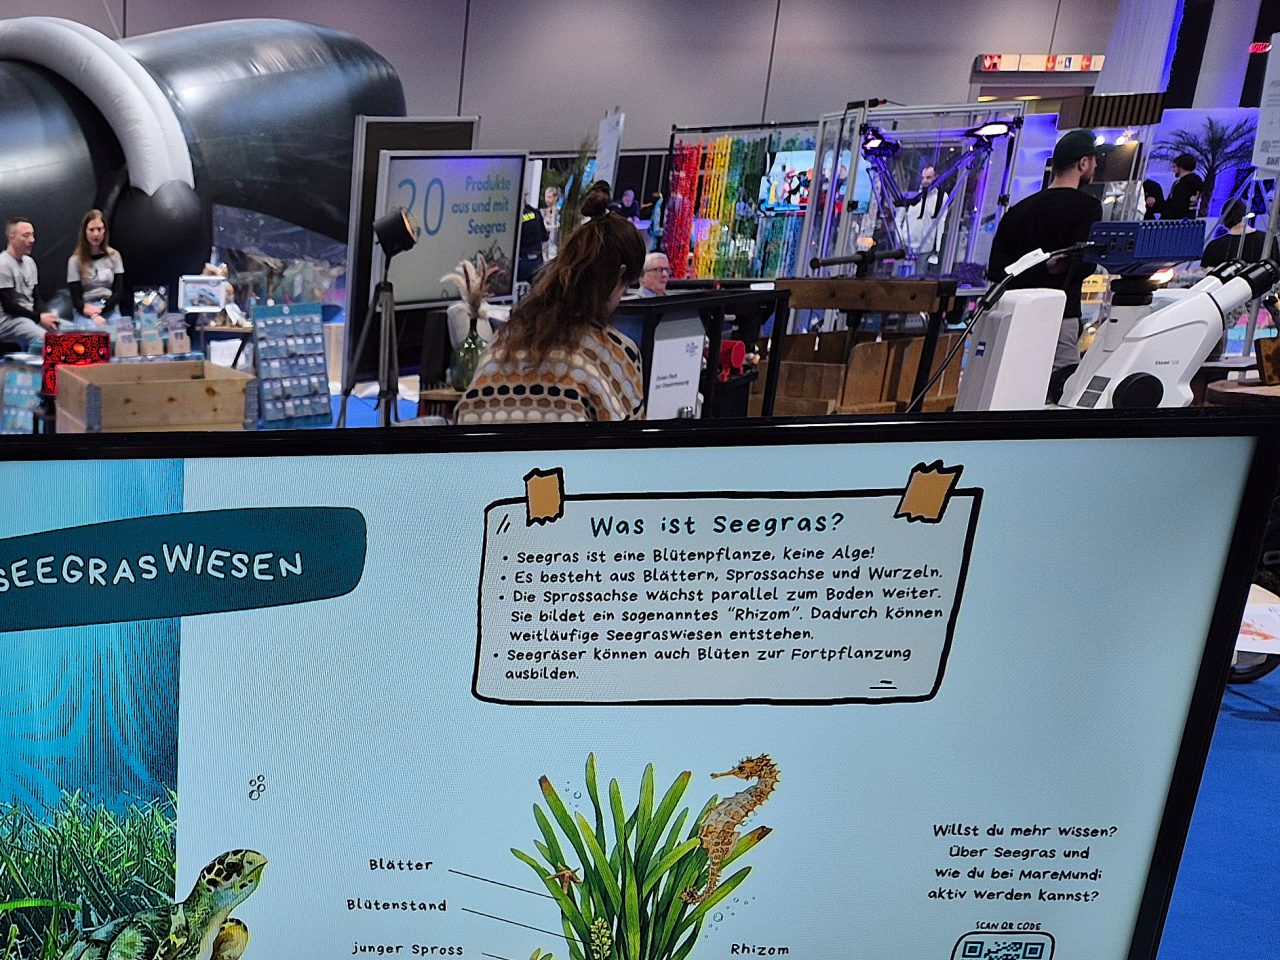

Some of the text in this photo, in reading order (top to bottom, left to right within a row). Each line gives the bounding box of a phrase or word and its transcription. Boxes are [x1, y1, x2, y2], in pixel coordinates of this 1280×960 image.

[466, 175, 512, 191] Produkte
[451, 197, 509, 213] aus und mit
[467, 218, 507, 238] Seegras
[590, 512, 844, 538] Was ist Seegras?
[516, 544, 875, 566] Seegras ist eine Blütenpflanze, keine Alge!
[515, 564, 942, 584] Es besteht aus Blättern, Sprossachse und Wurzeln.
[513, 590, 536, 603] Die
[543, 588, 638, 606] Sprossachse
[711, 586, 778, 604] parallel
[786, 590, 818, 602] zum
[826, 585, 873, 601] Boden
[511, 611, 532, 623] Sie
[539, 608, 586, 625] bildet
[593, 610, 615, 622] ein
[621, 609, 718, 625] sogenanntes
[811, 605, 878, 620] Dadurch
[885, 605, 943, 620] können
[606, 629, 722, 644] Seegraswiesen
[729, 626, 814, 641] entstehen.
[507, 645, 911, 664] Seegräser können auch Blüten zur Fortpflanzung
[505, 666, 580, 682] ausbilden.
[933, 823, 979, 837] Willst
[986, 823, 1004, 837] du
[1010, 824, 1052, 836] mehr
[949, 844, 1090, 861] Über Seegras und
[369, 857, 433, 871] Blätter
[967, 868, 985, 879] du
[991, 868, 1014, 880] bei
[1018, 867, 1103, 882] MareMundi
[928, 886, 967, 901] aktiv
[1038, 888, 1100, 903] kannst?
[347, 897, 446, 912] Blütenstand
[976, 921, 1042, 931] SCAN QR CODE
[352, 941, 463, 957] junger Spross
[731, 942, 789, 956] Rhizom
